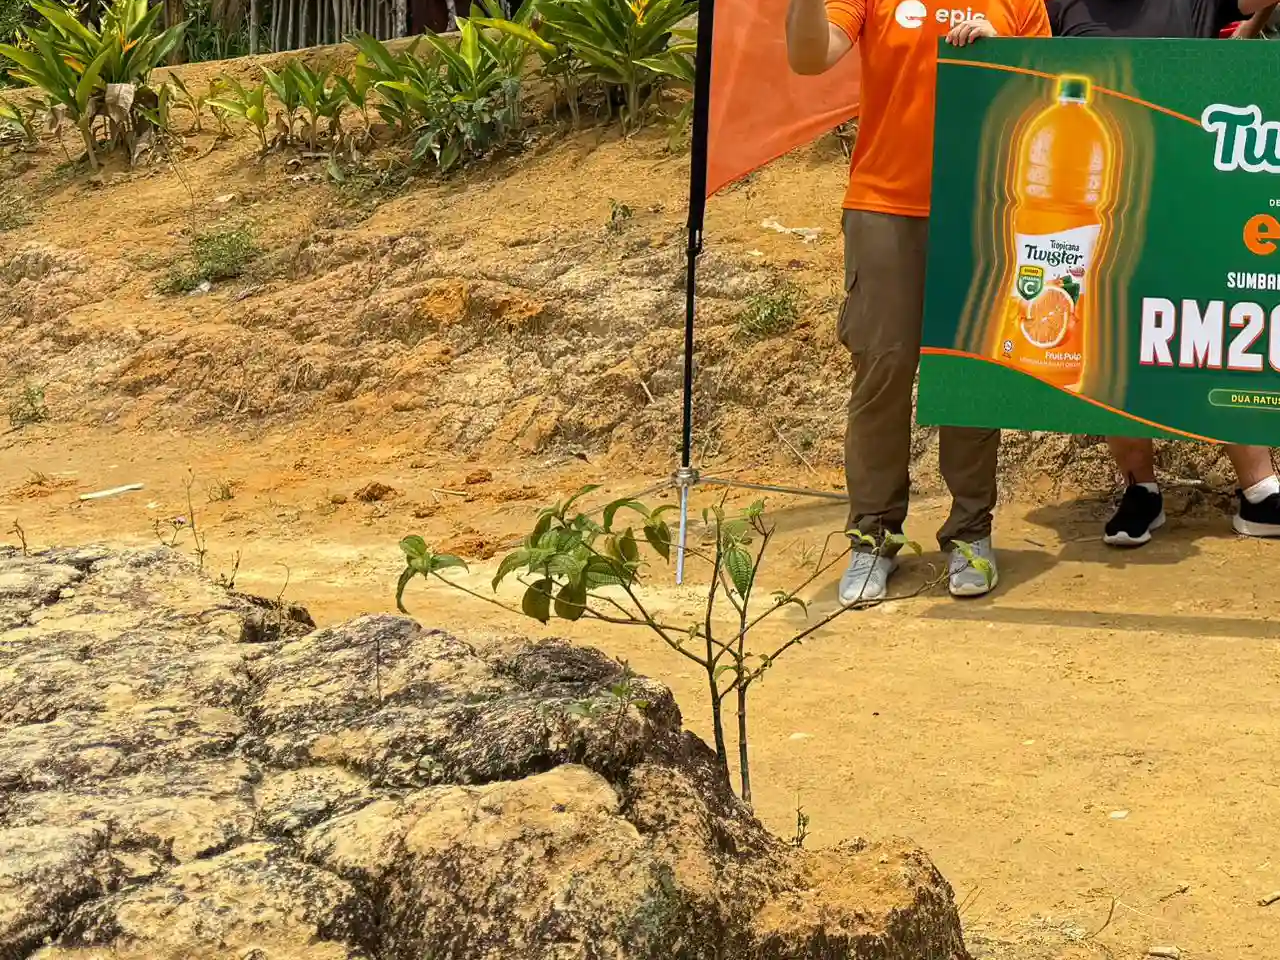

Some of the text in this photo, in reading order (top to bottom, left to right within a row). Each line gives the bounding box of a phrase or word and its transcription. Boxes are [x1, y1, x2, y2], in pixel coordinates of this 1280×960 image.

[1050, 240, 1080, 252] Tropicana
[1025, 244, 1084, 267] Twister
[1231, 394, 1251, 403] DUA
